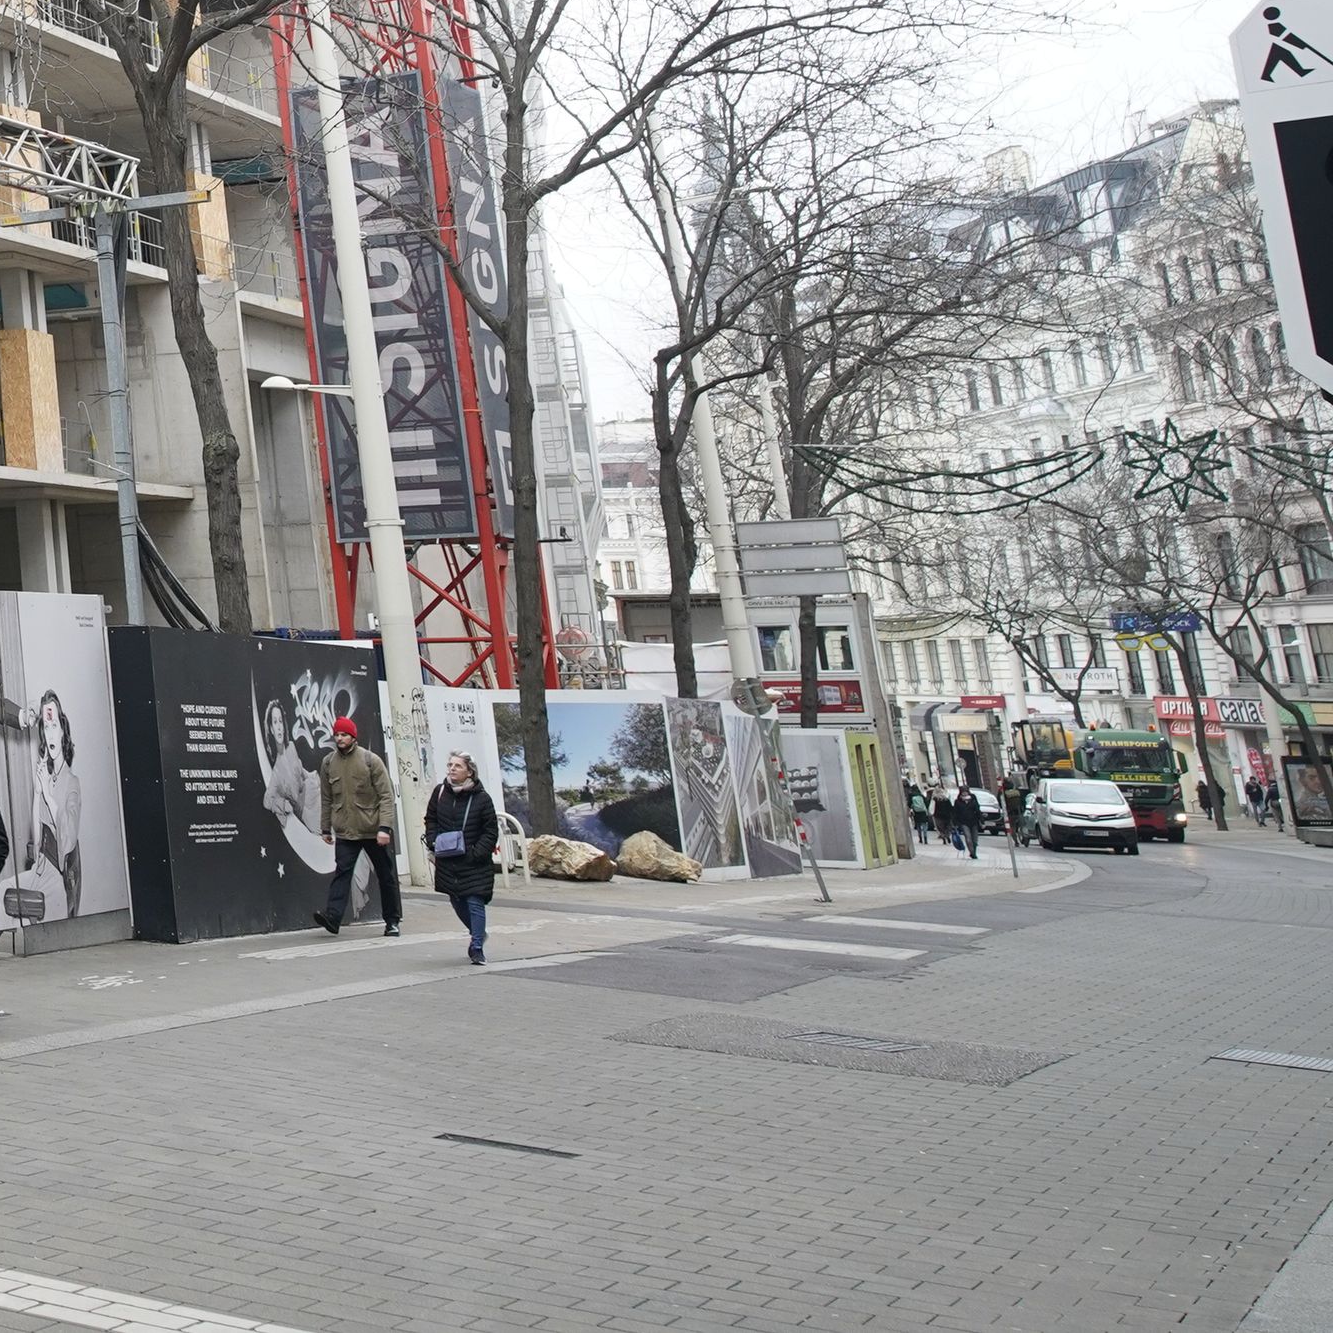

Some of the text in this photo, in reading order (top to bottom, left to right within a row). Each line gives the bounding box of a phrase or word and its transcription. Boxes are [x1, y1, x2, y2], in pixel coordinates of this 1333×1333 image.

[453, 118, 509, 395] SGNA
[1162, 700, 1208, 716] OPTIKR
[1220, 699, 1261, 723] carla
